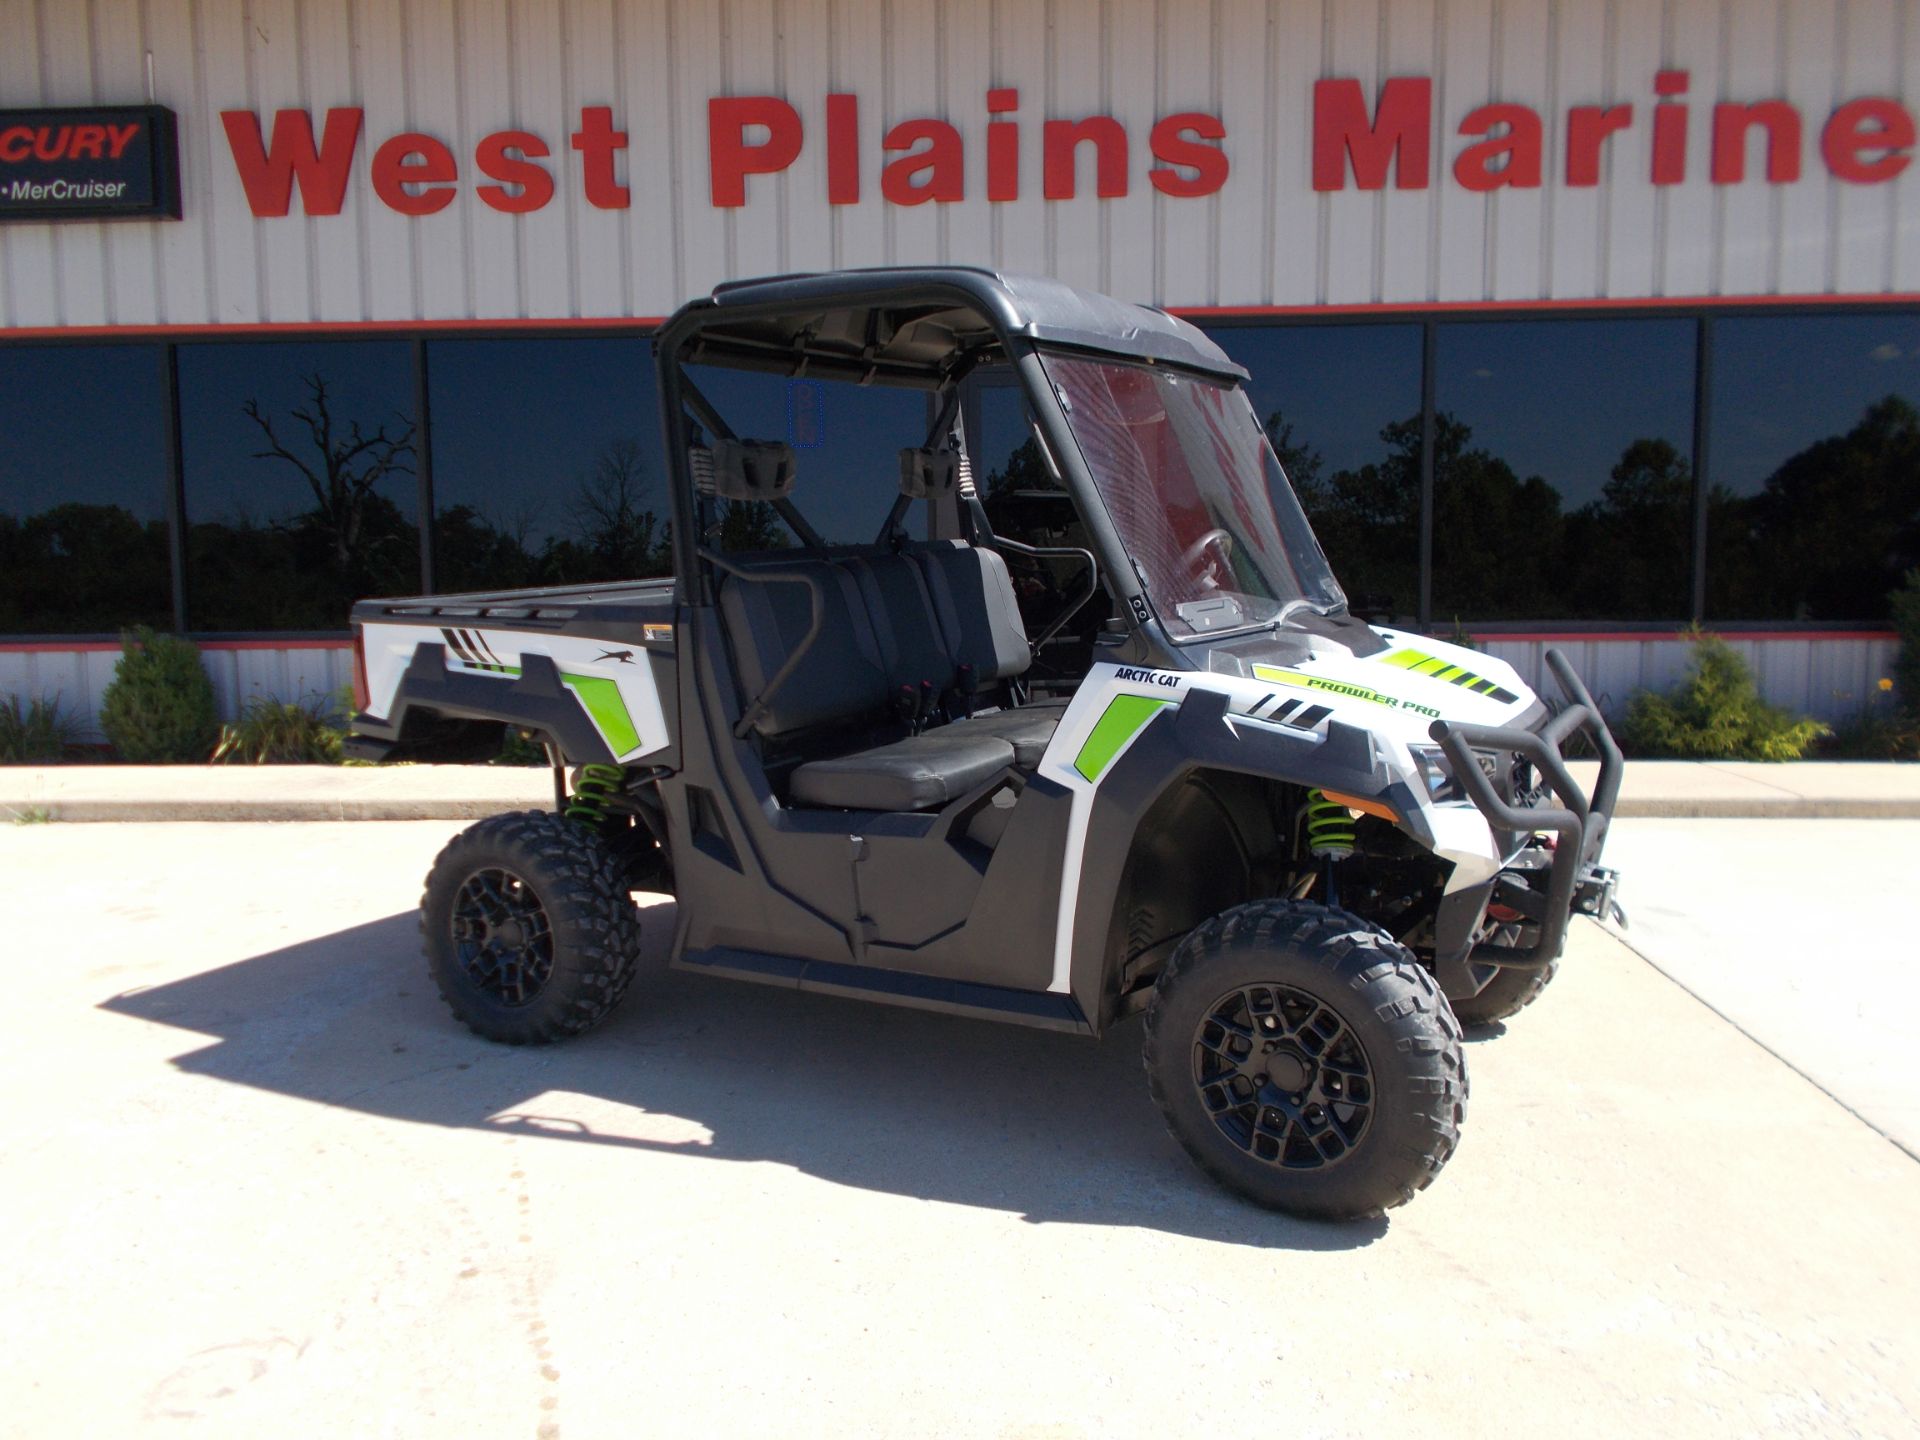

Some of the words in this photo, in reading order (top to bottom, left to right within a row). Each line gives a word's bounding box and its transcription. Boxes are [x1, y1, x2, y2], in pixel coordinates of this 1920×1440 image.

[220, 106, 631, 217] West
[709, 88, 1230, 207] Plains
[1312, 69, 1917, 192] Marine
[11, 179, 126, 200] MerCruiser
[1114, 667, 1157, 684] ARCTIC
[1158, 674, 1181, 687] CAT
[1307, 679, 1399, 707] PROWLER
[1402, 701, 1440, 718] PRO
